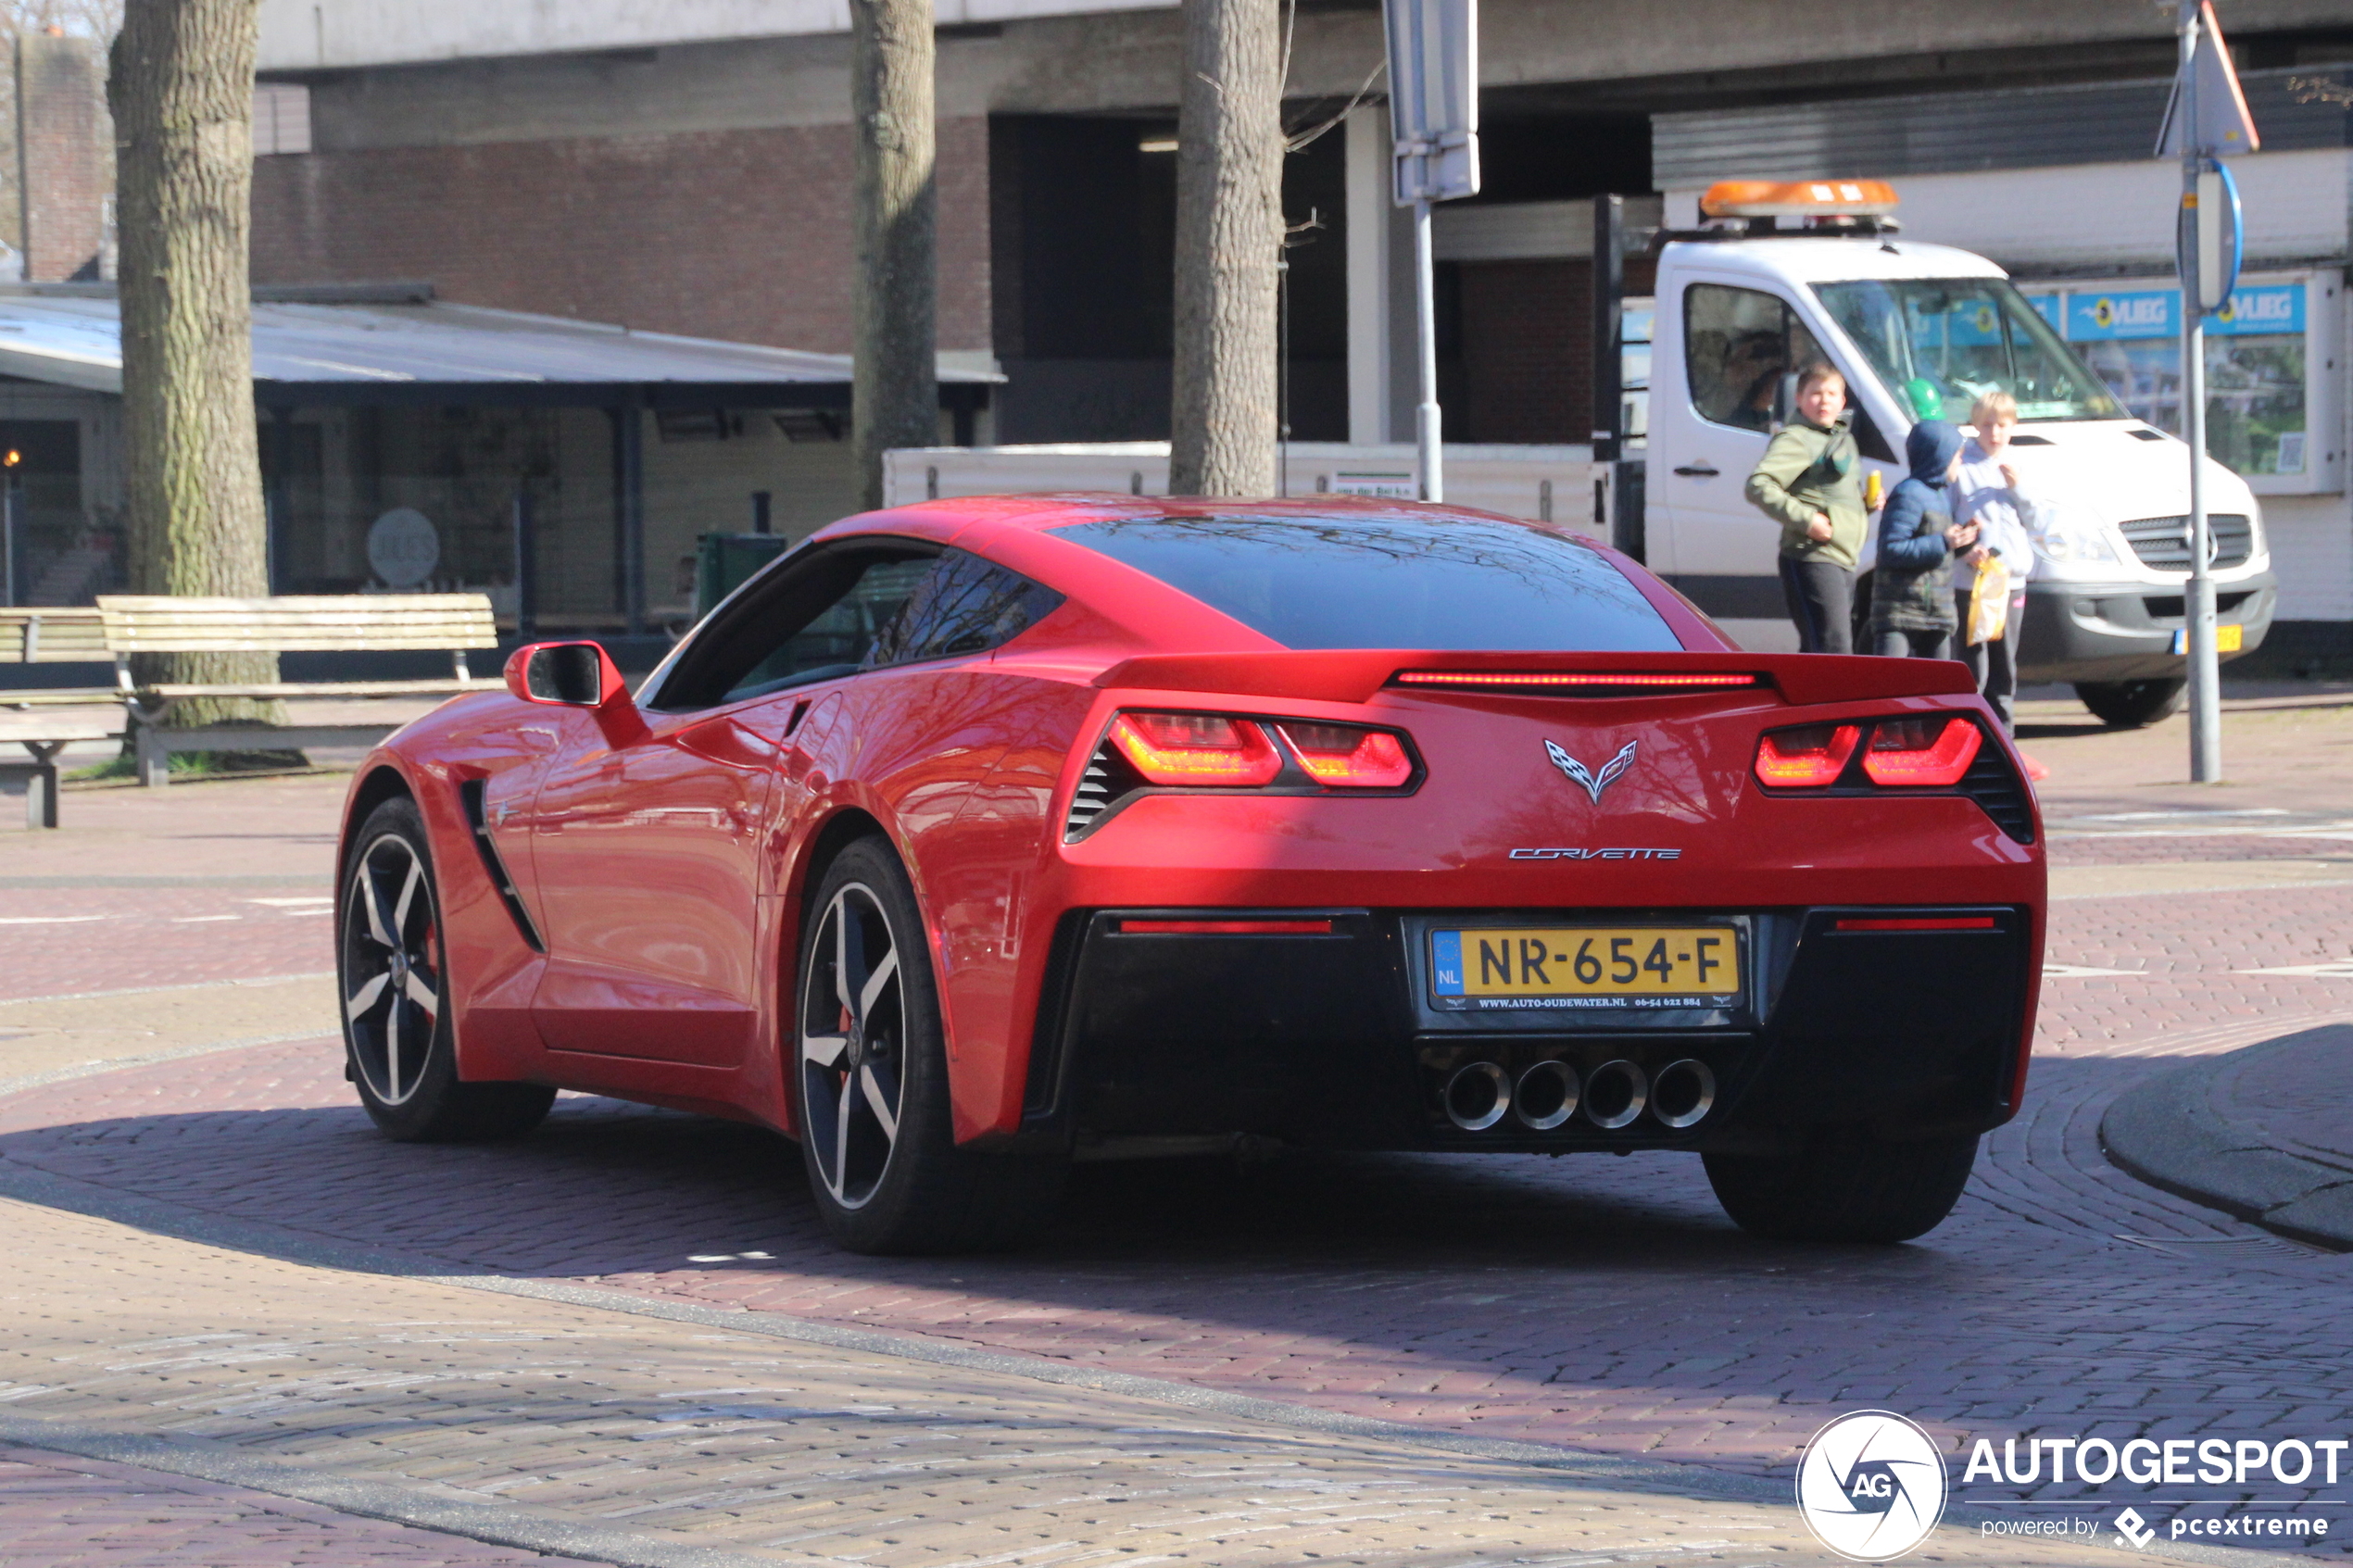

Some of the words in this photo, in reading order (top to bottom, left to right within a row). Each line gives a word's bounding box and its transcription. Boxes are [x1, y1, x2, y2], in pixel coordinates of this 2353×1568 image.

[1508, 847, 1681, 860] CORVETTE
[1479, 937, 1720, 985] NR-654-F
[1439, 970, 1459, 985] NL
[1479, 997, 1628, 1009] WWW.AUTO-OUDEWATER.NL
[1634, 997, 1661, 1008] 06-54
[1664, 997, 1681, 1007] 622
[1683, 997, 1701, 1007] 884
